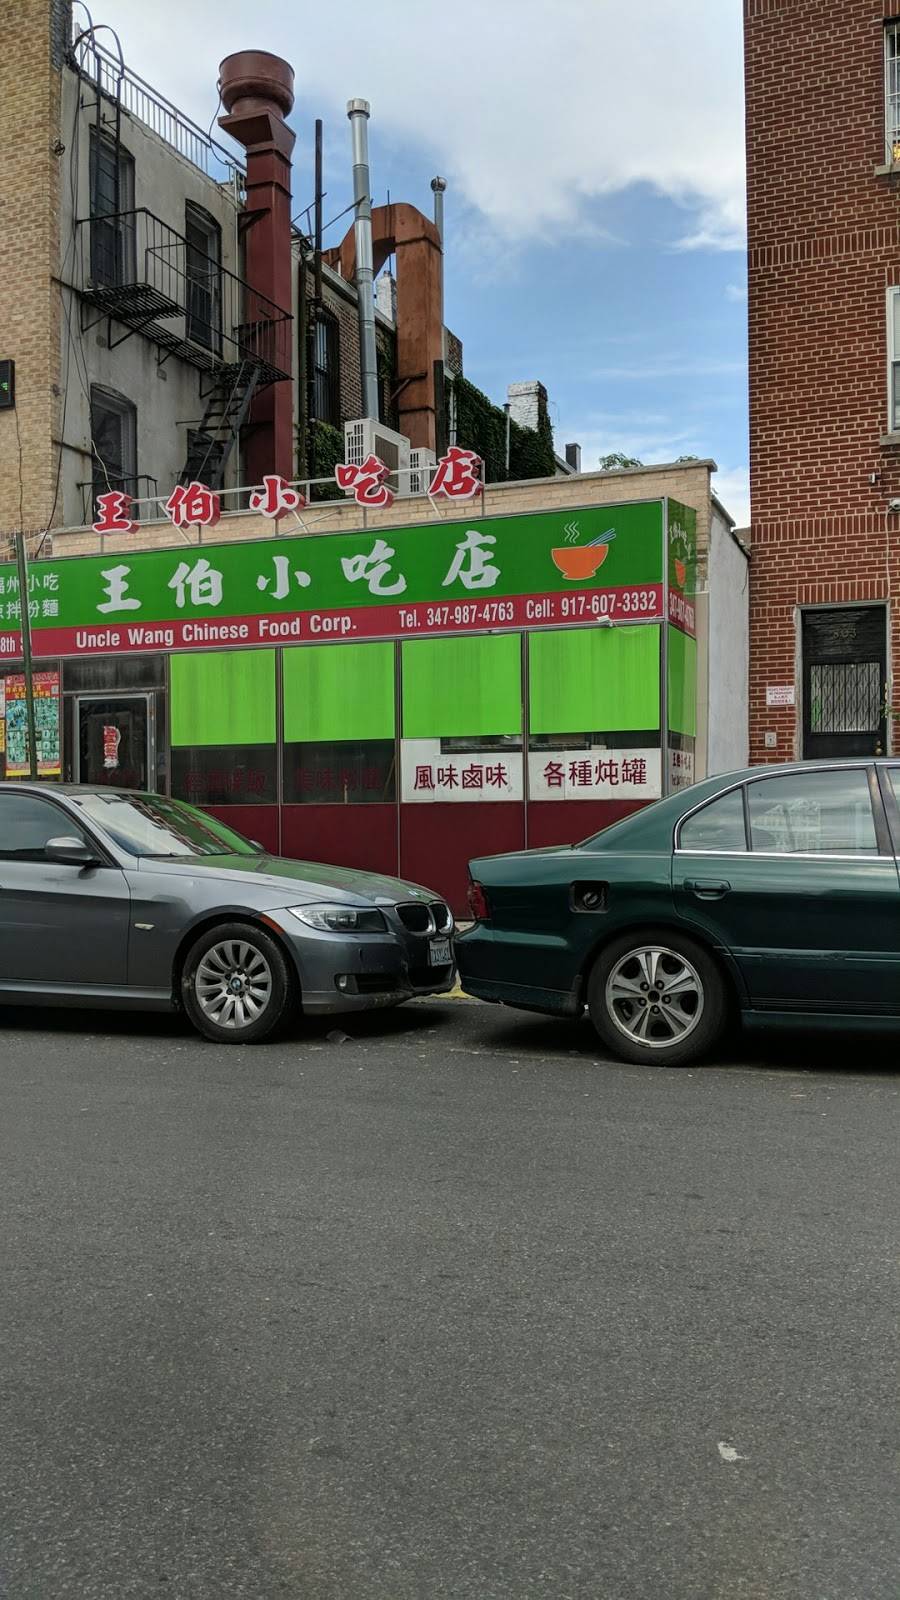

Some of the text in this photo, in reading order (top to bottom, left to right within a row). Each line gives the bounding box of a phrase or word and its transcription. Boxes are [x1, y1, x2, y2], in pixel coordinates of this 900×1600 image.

[92, 446, 484, 534] 王伯小吃店
[96, 530, 501, 614] 王伯小吃店
[76, 631, 121, 649] Uncle
[127, 628, 174, 646] Wang
[182, 623, 249, 642] Chinese
[258, 618, 300, 637] Food
[310, 613, 357, 634] Corp.
[398, 608, 421, 628] Tel.
[426, 601, 515, 626] 347-987-4763
[525, 597, 555, 619] Cell:
[560, 590, 657, 618] 917-607-3332
[543, 758, 647, 787] 各種炖罐
